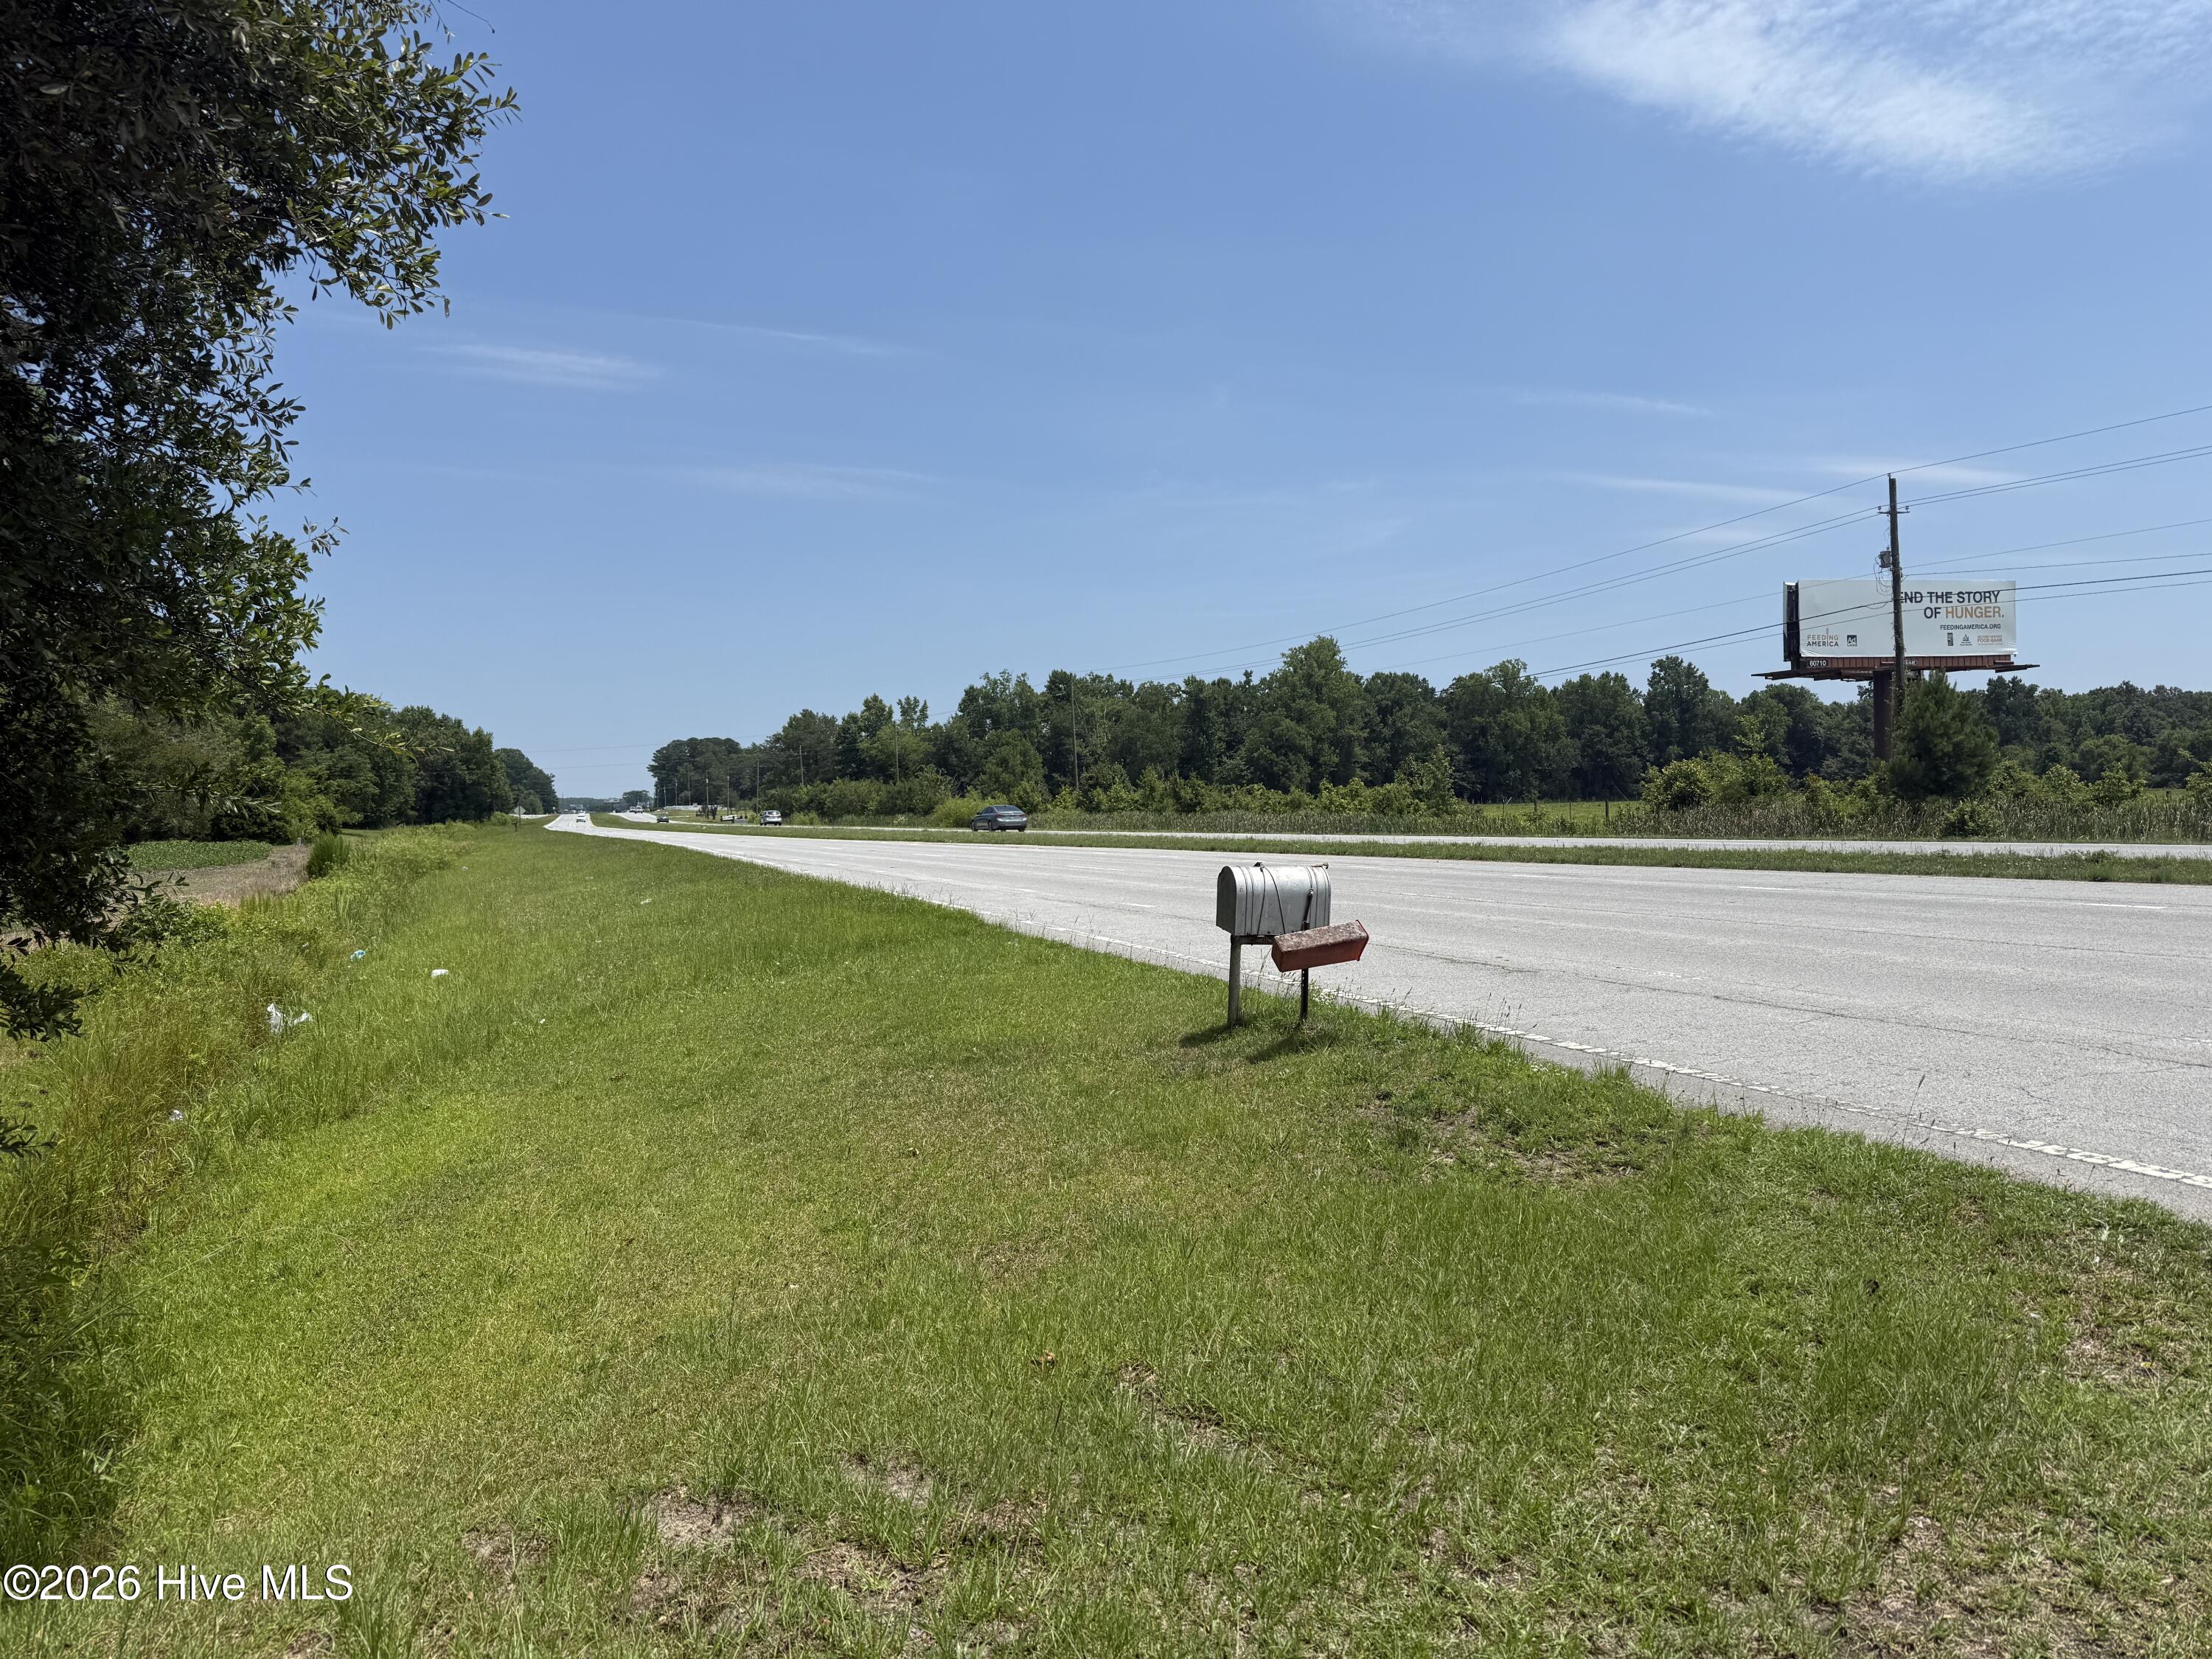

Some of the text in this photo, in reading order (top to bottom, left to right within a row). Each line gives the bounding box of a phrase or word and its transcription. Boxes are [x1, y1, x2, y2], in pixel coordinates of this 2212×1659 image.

[1927, 591, 1953, 603] THE
[1957, 591, 2000, 603] STORY
[1924, 606, 2005, 619] OF HUNGER.
